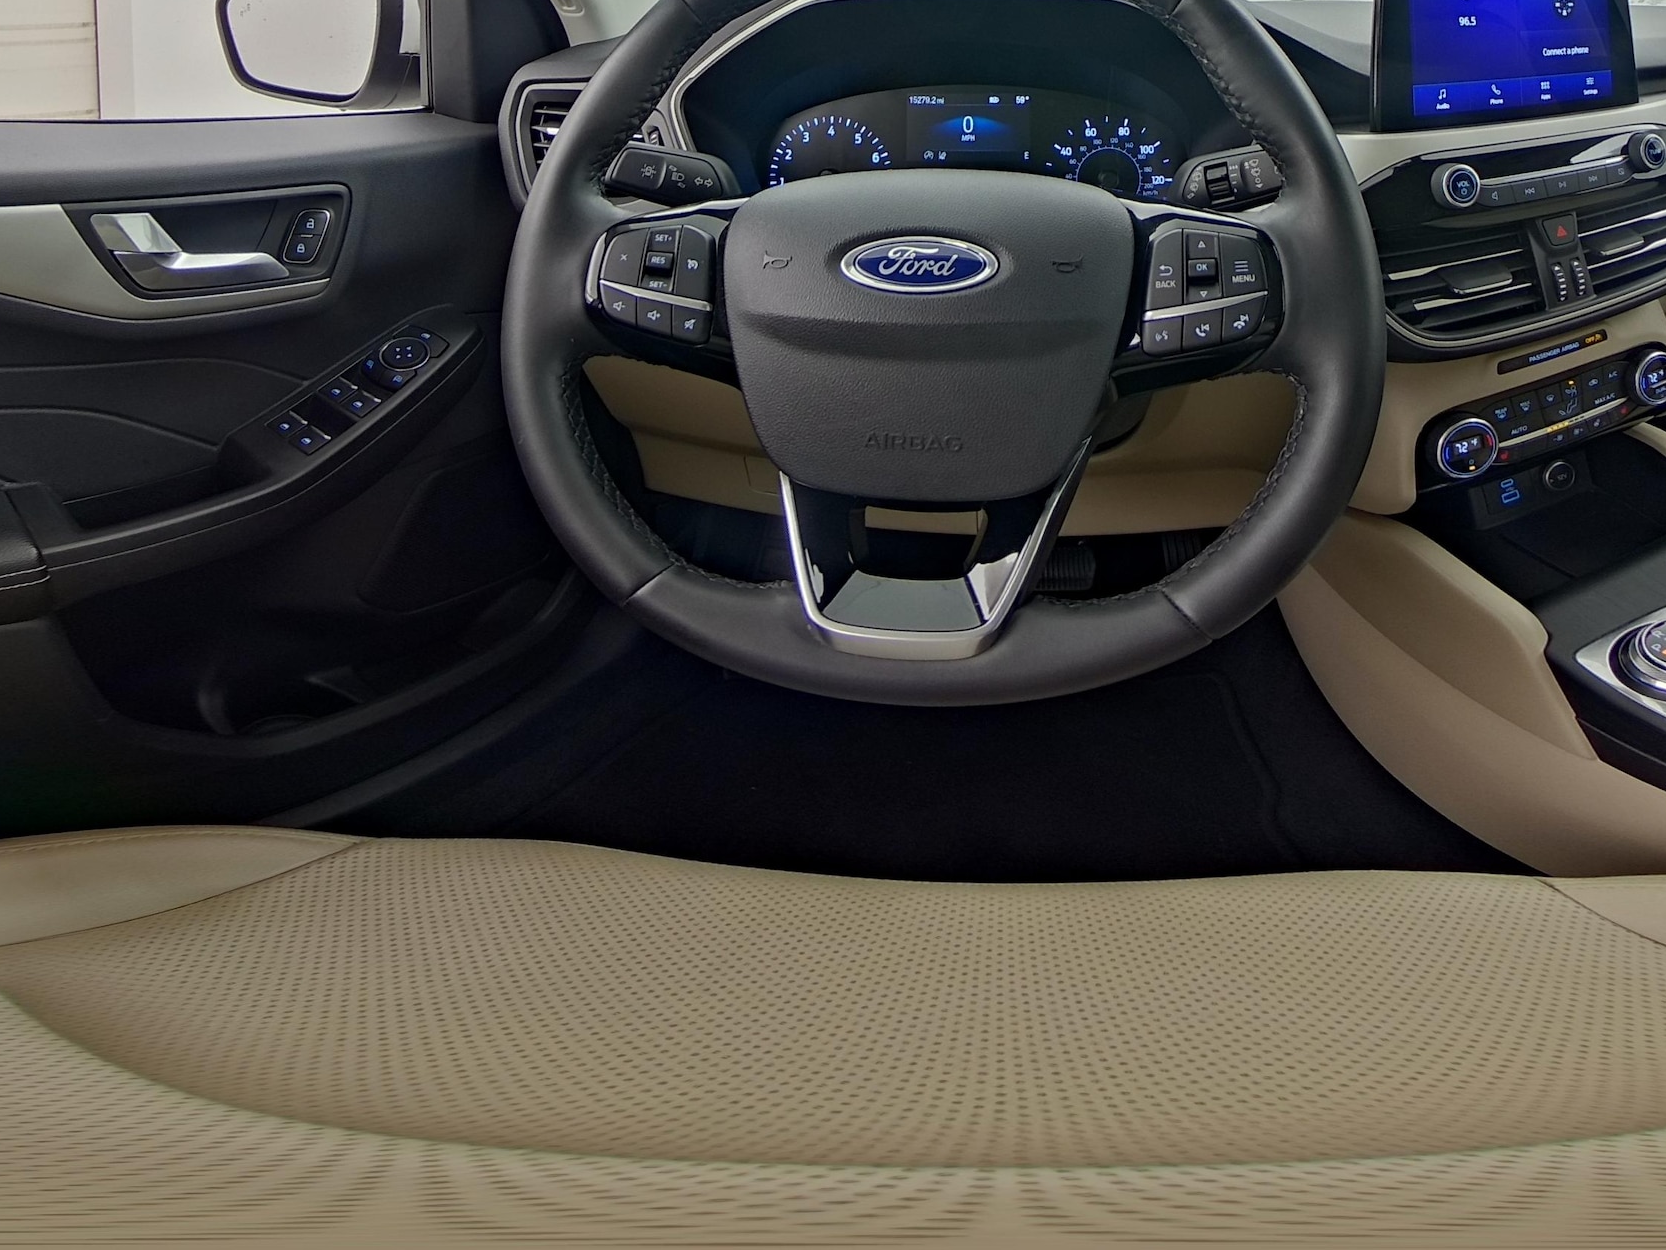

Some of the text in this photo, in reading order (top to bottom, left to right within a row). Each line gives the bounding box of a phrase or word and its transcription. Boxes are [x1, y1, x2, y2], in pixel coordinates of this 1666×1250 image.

[1458, 16, 1477, 27] 96.5
[1542, 46, 1566, 57] Connect
[1571, 45, 1589, 56] phone
[1435, 102, 1450, 111] Audio
[962, 115, 973, 133] 0
[827, 125, 835, 137] 4
[1085, 127, 1097, 137] 60
[1118, 126, 1130, 137] 80
[802, 131, 810, 143] 3
[854, 132, 863, 144] 5
[960, 134, 976, 142] MPH
[784, 149, 793, 161] 2
[1060, 146, 1072, 156] 40
[1139, 145, 1155, 155] 100
[871, 151, 880, 163] 6
[1151, 175, 1165, 186] 120
[654, 233, 673, 242] SET+
[650, 256, 666, 264] RES
[878, 246, 960, 276] Ford
[1196, 263, 1209, 271] OK
[1231, 273, 1256, 284] MENU
[1155, 280, 1176, 289] BACK
[1528, 336, 1595, 363] PASSENGER AIRBAG OFF
[1510, 425, 1528, 435] AUTO
[863, 431, 964, 453] AIRBAG
[1455, 441, 1468, 454] 72
[1651, 643, 1662, 652] P
